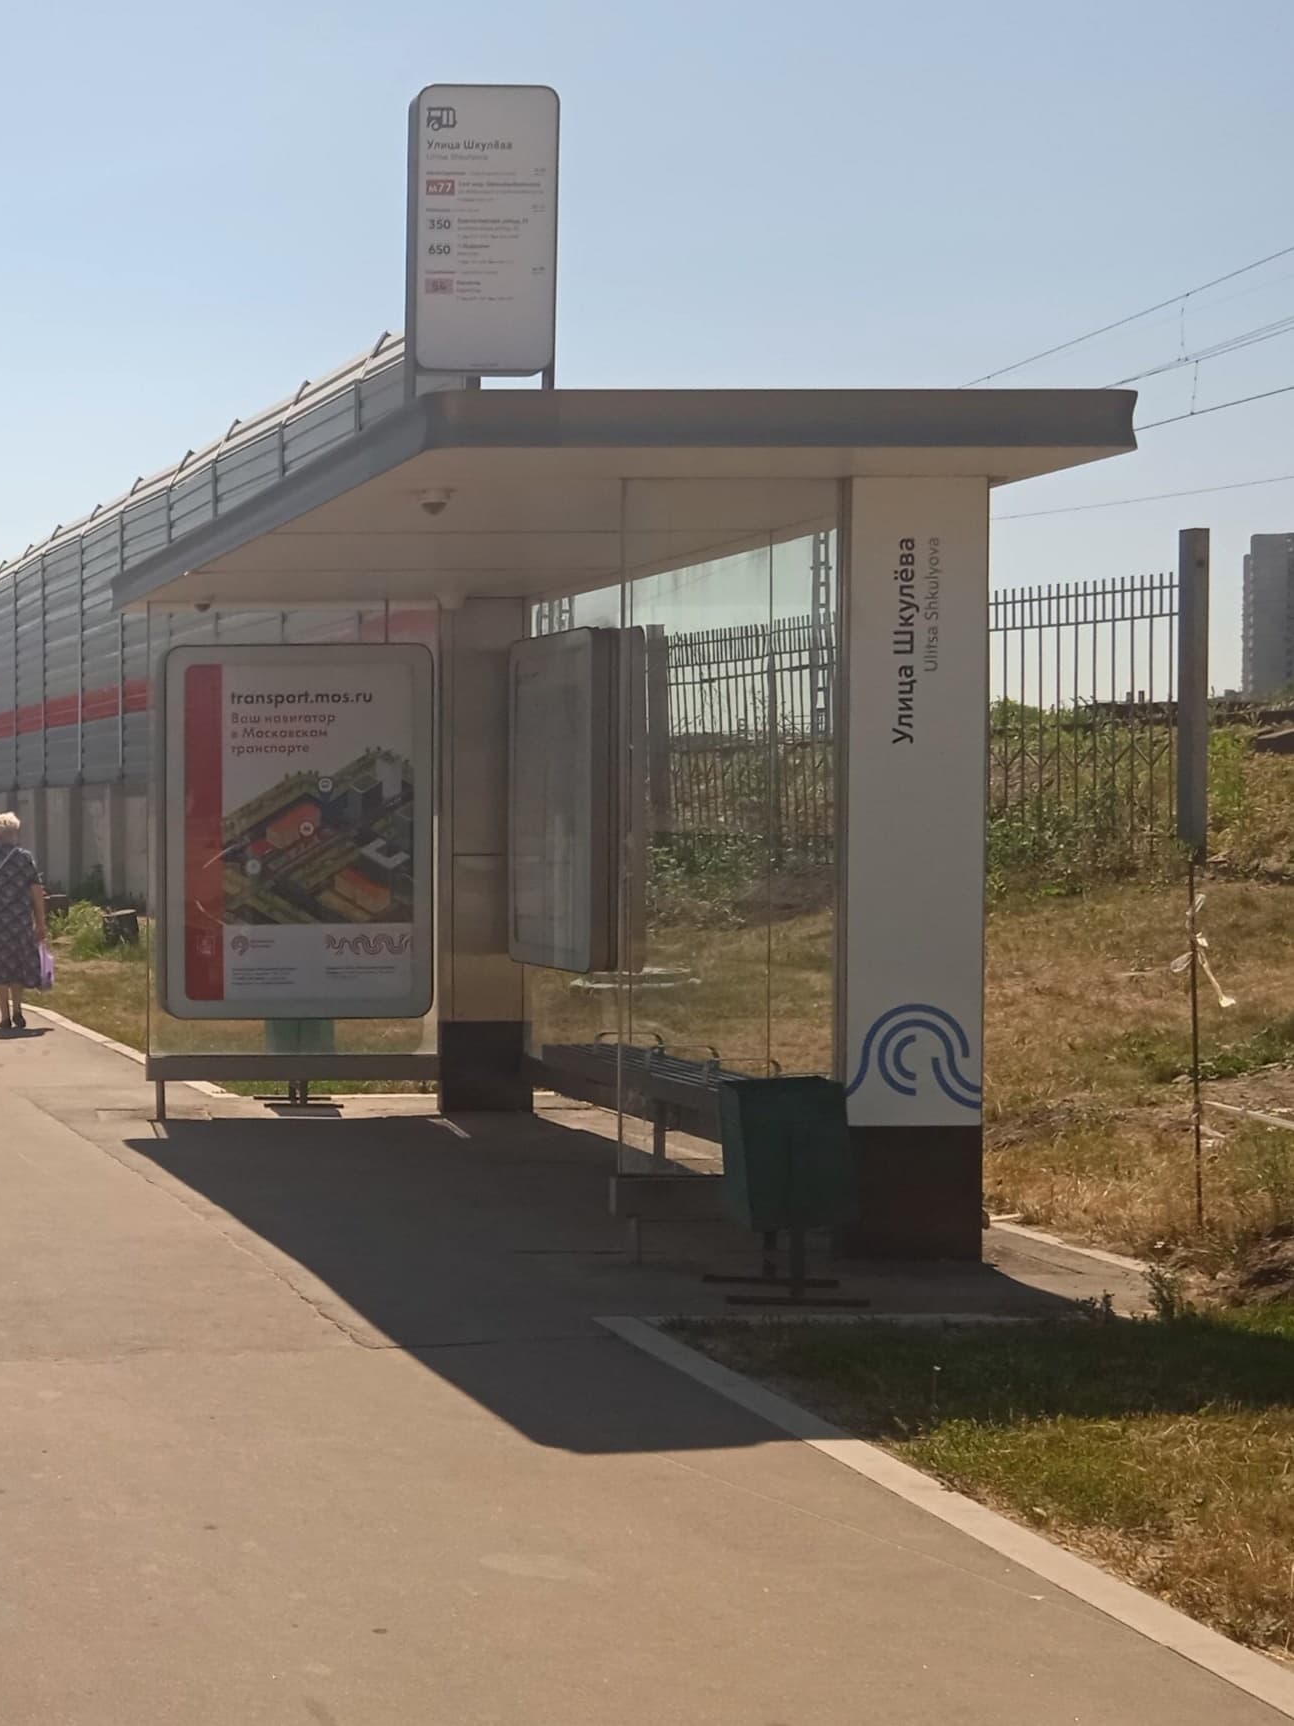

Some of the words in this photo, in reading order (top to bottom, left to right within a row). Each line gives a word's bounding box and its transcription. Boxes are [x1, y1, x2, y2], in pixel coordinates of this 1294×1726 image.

[426, 139, 460, 150] Улица
[463, 140, 513, 152] Шкулёва
[428, 218, 451, 230] 350
[428, 244, 451, 255] 650
[924, 536, 943, 621] Shkulyova
[893, 537, 920, 656] Шкулёва
[924, 628, 939, 672] Ulitsa
[231, 690, 373, 708] transport.mos.ru
[892, 664, 917, 744] Улица
[231, 712, 260, 724] Ваш
[264, 713, 336, 726] навигатор
[242, 727, 329, 739] Московском
[231, 744, 310, 756] транспорте
